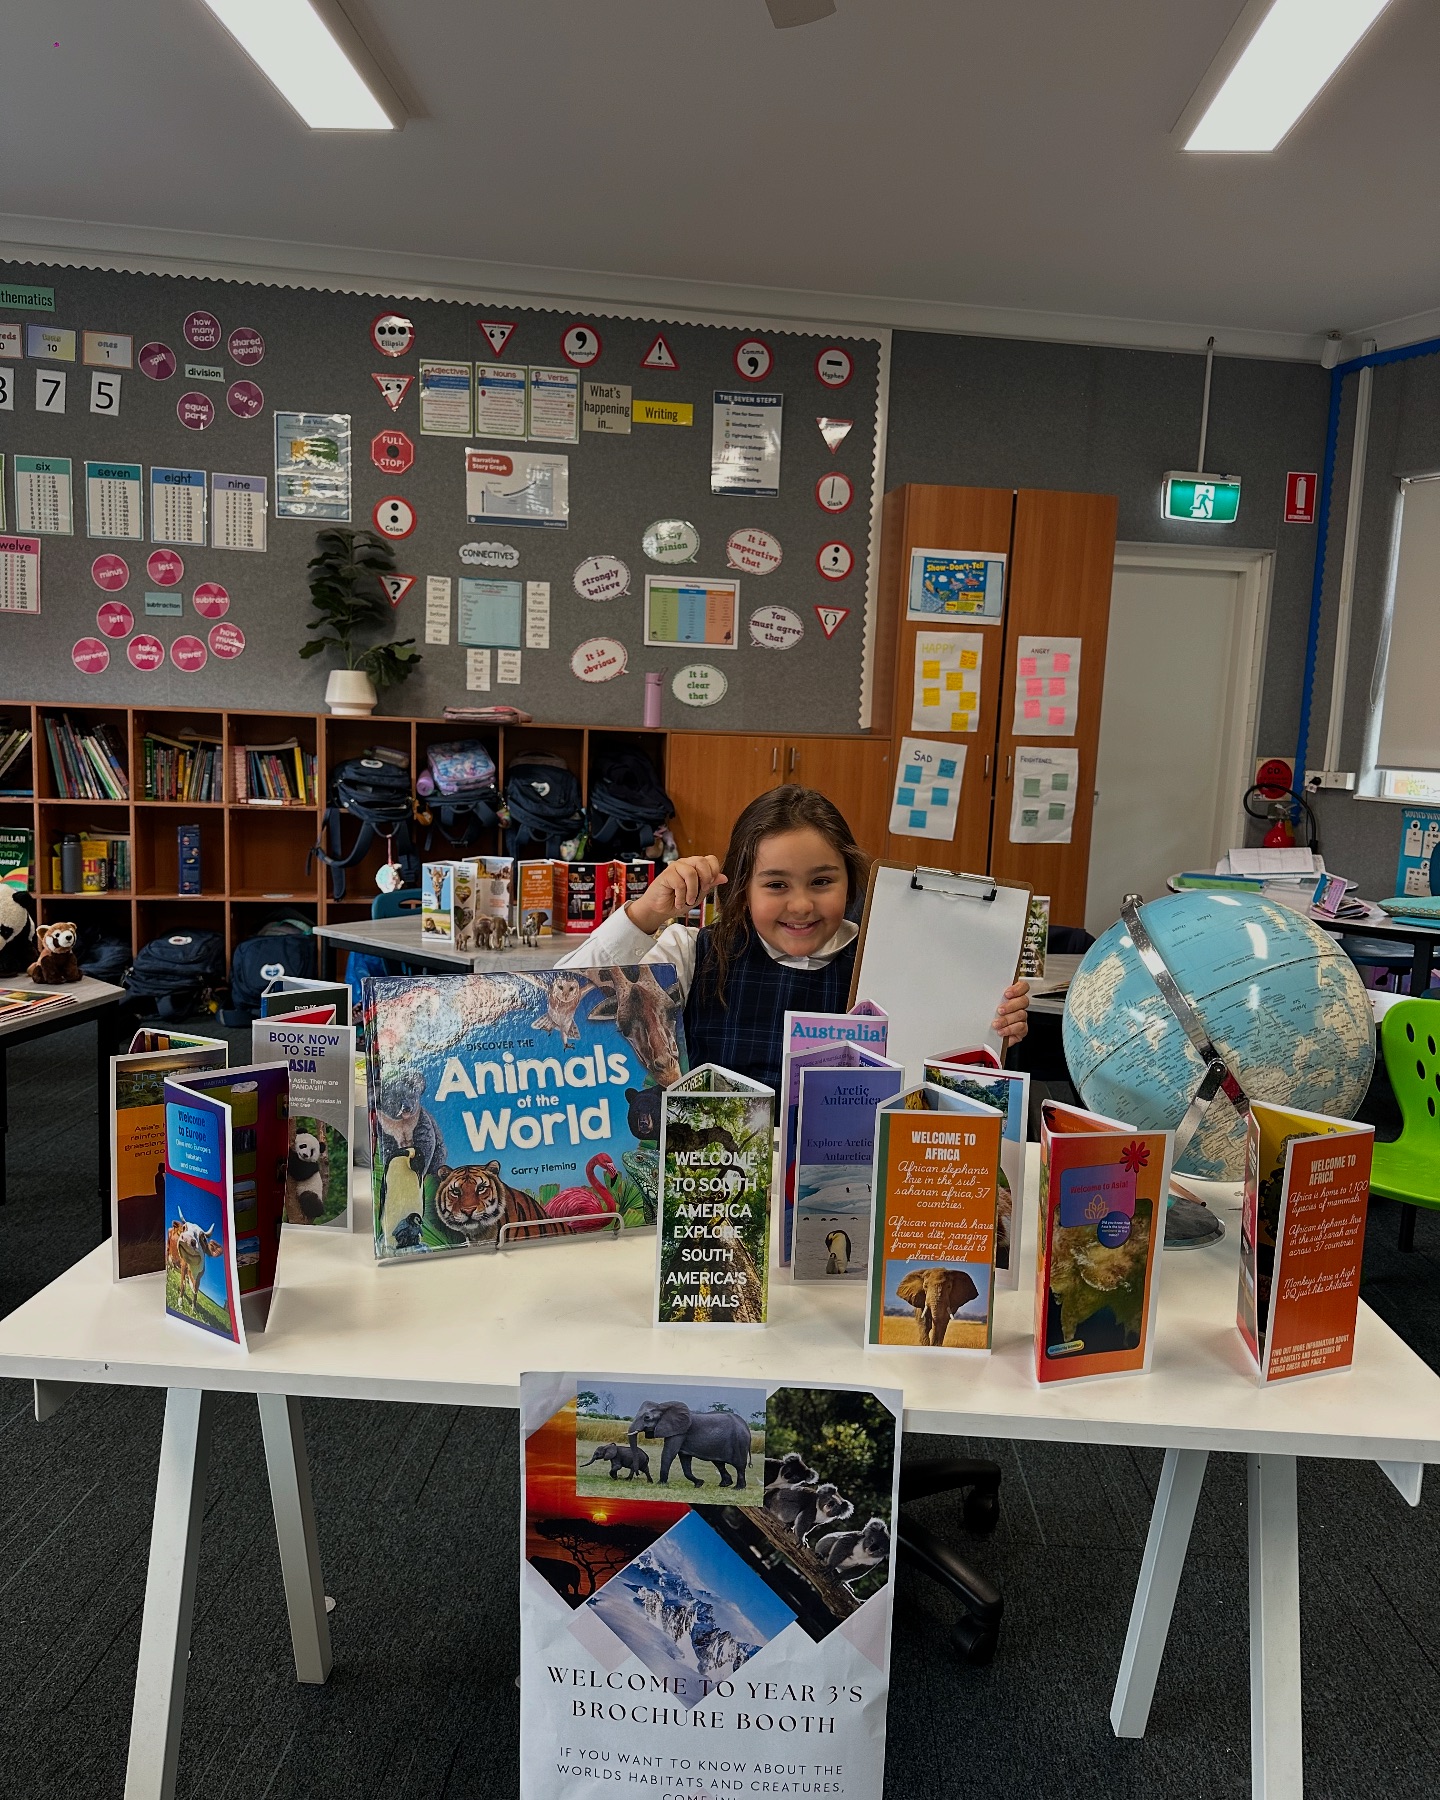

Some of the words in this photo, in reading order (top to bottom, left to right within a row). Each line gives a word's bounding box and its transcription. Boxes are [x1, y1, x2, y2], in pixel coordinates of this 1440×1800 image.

[193, 318, 211, 326] how
[192, 327, 215, 336] many
[98, 340, 118, 348] ones
[193, 334, 215, 342] each
[232, 338, 260, 346] shared
[381, 340, 404, 348] Ellipsis
[48, 344, 58, 352] 10
[232, 346, 262, 355] equally
[742, 348, 764, 356] Comma
[150, 353, 166, 366] split
[188, 368, 221, 378] division
[430, 367, 468, 376] Adjectives
[493, 370, 516, 378] Nouns
[822, 371, 844, 380] Hyphen
[548, 374, 568, 382] Verbs
[42, 378, 61, 406] 7
[96, 382, 114, 409] 5
[234, 392, 248, 404] out
[590, 385, 621, 399] What's
[720, 394, 732, 402] THE
[184, 402, 208, 413] equal
[584, 403, 630, 417] happening
[185, 410, 208, 421] parts
[645, 406, 678, 422] Writing
[598, 418, 613, 429] in...
[382, 437, 404, 445] FULL
[380, 458, 404, 468] STOP!
[472, 456, 500, 464] Narrative
[35, 462, 51, 471] six
[489, 464, 507, 472] Graph
[98, 468, 130, 478] seven
[164, 473, 192, 484] eight
[228, 480, 250, 490] nine
[462, 549, 514, 561] CONNECTIVES
[729, 541, 778, 563] imperative
[158, 562, 174, 571] less
[742, 557, 761, 569] that
[926, 562, 984, 572] Show-Don't-Tell
[99, 568, 124, 579] minus
[581, 569, 619, 586] strongly
[587, 580, 621, 596] believe
[196, 596, 228, 604] subtract
[108, 615, 123, 623] left
[771, 612, 786, 622] You
[220, 628, 237, 637] how
[752, 619, 773, 630] must
[775, 625, 801, 637] agree
[765, 633, 784, 643] that
[138, 644, 157, 652] take
[215, 643, 237, 653] more
[922, 643, 955, 653] HAPPY
[74, 650, 108, 662] difference
[136, 653, 160, 663] away
[178, 651, 202, 660] fewer
[583, 656, 617, 674] obvious
[689, 670, 697, 678] It
[700, 670, 708, 678] is
[687, 682, 710, 690] clear
[688, 692, 708, 700] that
[914, 750, 932, 763] SAD
[1404, 810, 1426, 820] SOUND
[791, 1022, 887, 1042] Australia!
[269, 1032, 305, 1044] BOOK
[309, 1034, 340, 1046] NOW
[466, 1040, 514, 1051] DISCOVER
[517, 1039, 534, 1049] THE
[282, 1045, 299, 1055] TO
[304, 1046, 325, 1057] SEE
[288, 1059, 316, 1073] ASIA
[133, 1073, 157, 1081] The
[434, 1044, 630, 1102] Animals
[834, 1085, 870, 1096] Arctic
[518, 1096, 534, 1109] of
[536, 1094, 559, 1106] the
[820, 1095, 881, 1106] Antarctica
[178, 1110, 205, 1127] Welcome
[134, 1124, 160, 1132] Asia's
[462, 1099, 612, 1152] World
[178, 1125, 185, 1136] to
[185, 1127, 207, 1142] Europe
[911, 1131, 961, 1145] WELCOME
[964, 1133, 976, 1145] TO
[807, 1138, 842, 1148] Explore
[844, 1138, 872, 1147] Arctic
[674, 1151, 757, 1166] WELCOME
[823, 1152, 871, 1161] Antarctica
[925, 1149, 960, 1161] AFRICA
[511, 1164, 539, 1176] Garry
[542, 1162, 577, 1175] Fleming
[898, 1161, 938, 1174] African
[940, 1164, 989, 1175] elephants
[1311, 1156, 1346, 1173] WELCOME
[1348, 1154, 1356, 1167] TO
[1309, 1171, 1334, 1186] AFRICA
[673, 1178, 697, 1192] TO
[699, 1178, 757, 1192] SOUTH
[1070, 1182, 1101, 1194] Welcome
[1103, 1181, 1110, 1190] to
[1111, 1180, 1128, 1189] Asia!
[1290, 1192, 1312, 1206] Africa
[1320, 1187, 1338, 1198] home
[1349, 1180, 1369, 1194] 1,100
[917, 1199, 965, 1210] countries.
[675, 1204, 752, 1218] AMERICA
[888, 1216, 927, 1229] African
[930, 1220, 967, 1230] animals
[969, 1221, 993, 1230] have
[674, 1226, 743, 1239] EXPLORE
[1289, 1224, 1316, 1238] African
[949, 1232, 988, 1244] ranging
[891, 1239, 916, 1252] from
[919, 1240, 974, 1252] meat-based
[976, 1243, 986, 1252] to
[681, 1249, 734, 1262] SOUTH
[906, 1251, 968, 1263] plant-based.
[666, 1271, 748, 1285] AMERICA'S
[1284, 1276, 1316, 1290] Monkeys
[672, 1294, 739, 1308] ANIMALS
[547, 1666, 687, 1695] WELCOME
[698, 1679, 735, 1698] TO
[747, 1682, 816, 1703] YEAR
[827, 1685, 863, 1706] 3'S
[572, 1700, 725, 1729] BROCHURE
[737, 1713, 835, 1734] BOOTH
[560, 1747, 573, 1757] IF
[579, 1749, 611, 1762] YOU
[617, 1753, 663, 1768] WANT
[671, 1758, 691, 1770] TO
[698, 1761, 747, 1773] KNOW
[753, 1763, 807, 1776] ABOUT
[814, 1765, 843, 1776] THE
[556, 1764, 622, 1781] WORLDS
[629, 1771, 704, 1788] HABITATS
[710, 1779, 743, 1790] AND
[750, 1781, 845, 1794] CREATURES,
